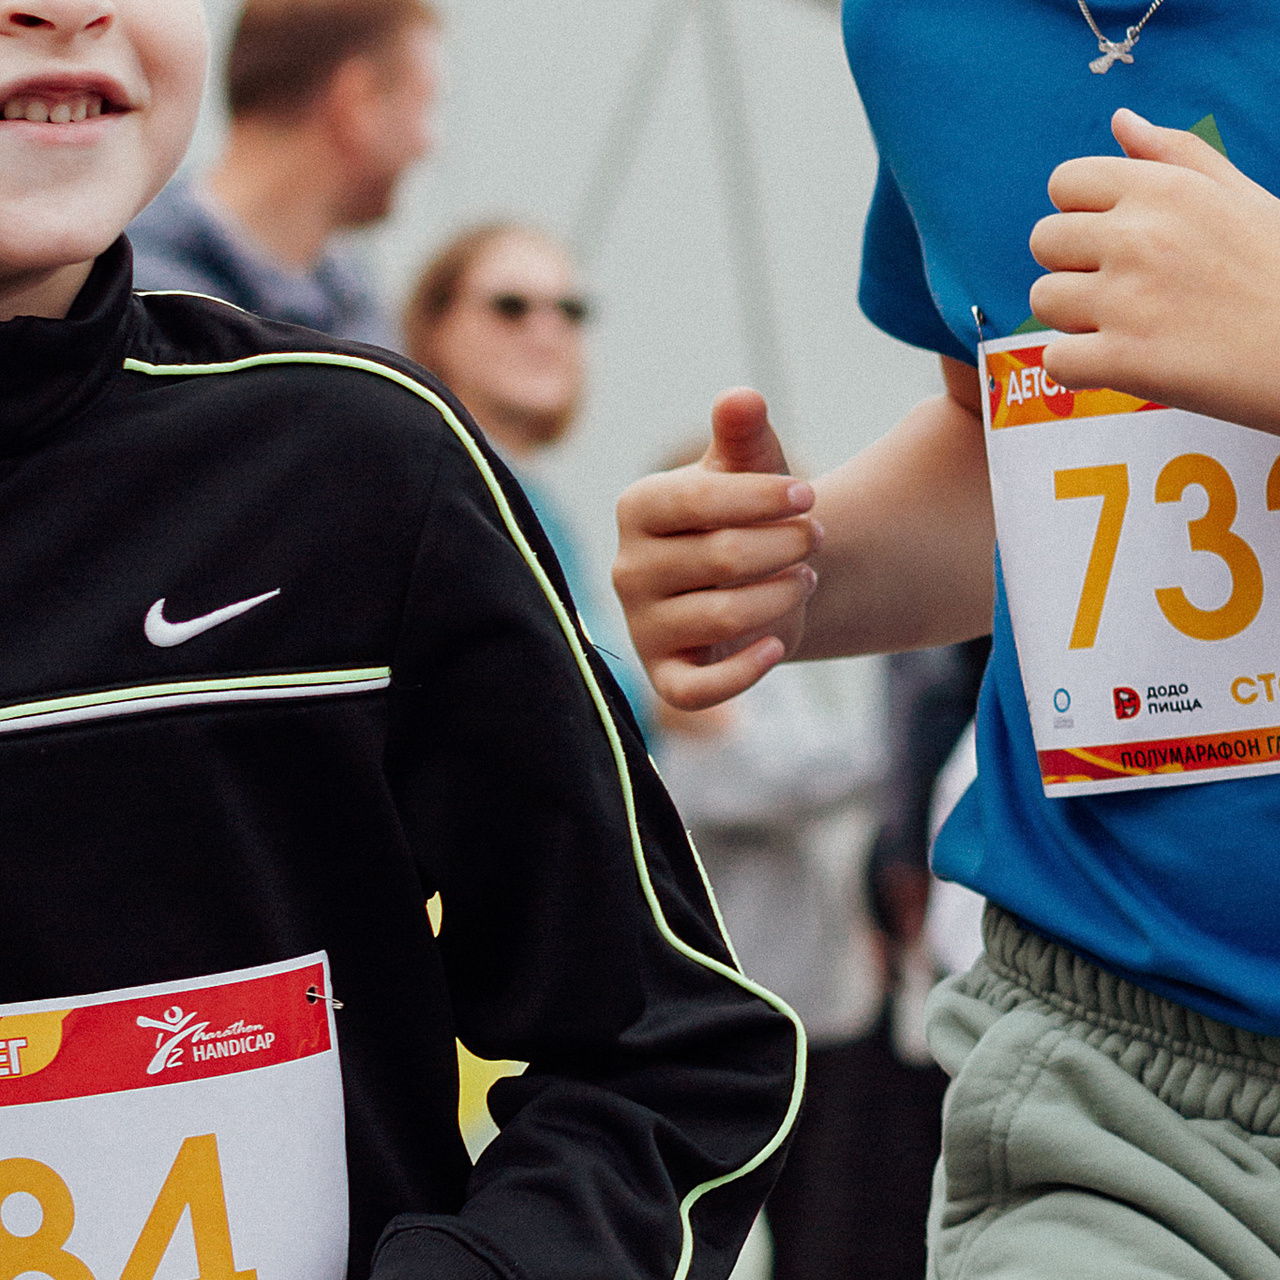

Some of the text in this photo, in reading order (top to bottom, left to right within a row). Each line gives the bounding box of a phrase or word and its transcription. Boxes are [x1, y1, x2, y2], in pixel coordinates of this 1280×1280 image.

[1006, 366, 1066, 406] ДЕТС
[1147, 684, 1188, 699] ДОДО
[1148, 697, 1202, 714] ПИЦЦА
[1121, 738, 1261, 769] ПОЛУМАРАФОН
[193, 1032, 275, 1062] HANDICAP
